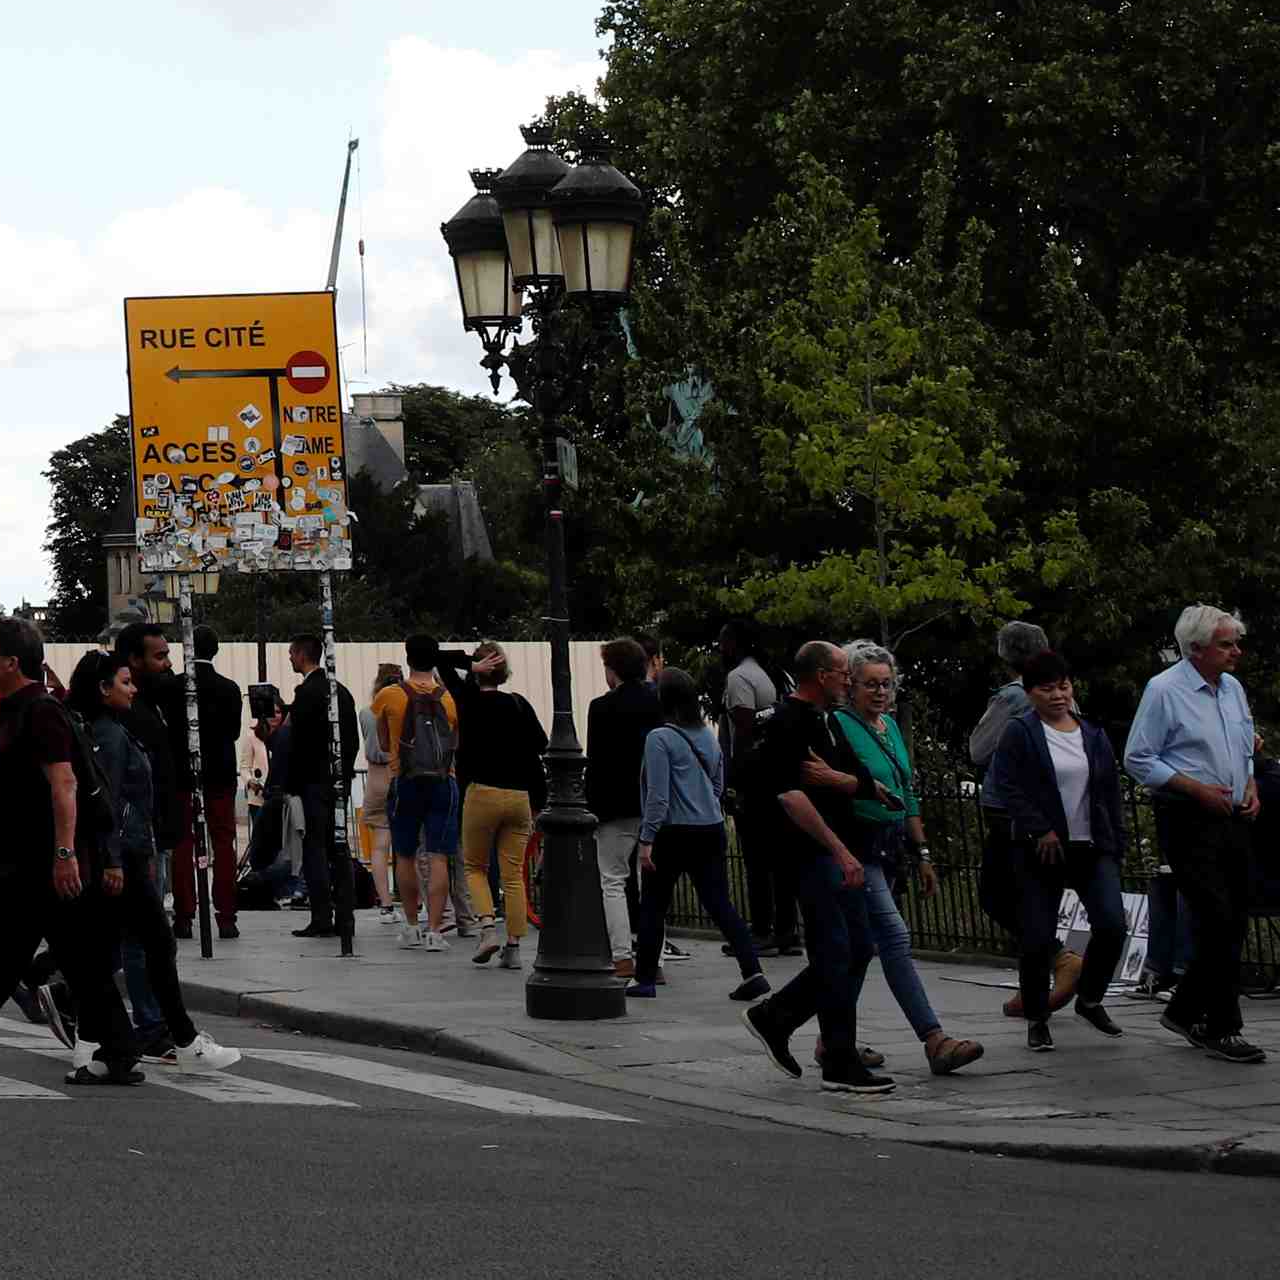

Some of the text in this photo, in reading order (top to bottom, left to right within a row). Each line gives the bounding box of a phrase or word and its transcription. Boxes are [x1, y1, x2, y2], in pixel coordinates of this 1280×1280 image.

[140, 320, 265, 349] RUE CITÉ
[283, 405, 337, 424] NTRE
[290, 435, 335, 455] AME
